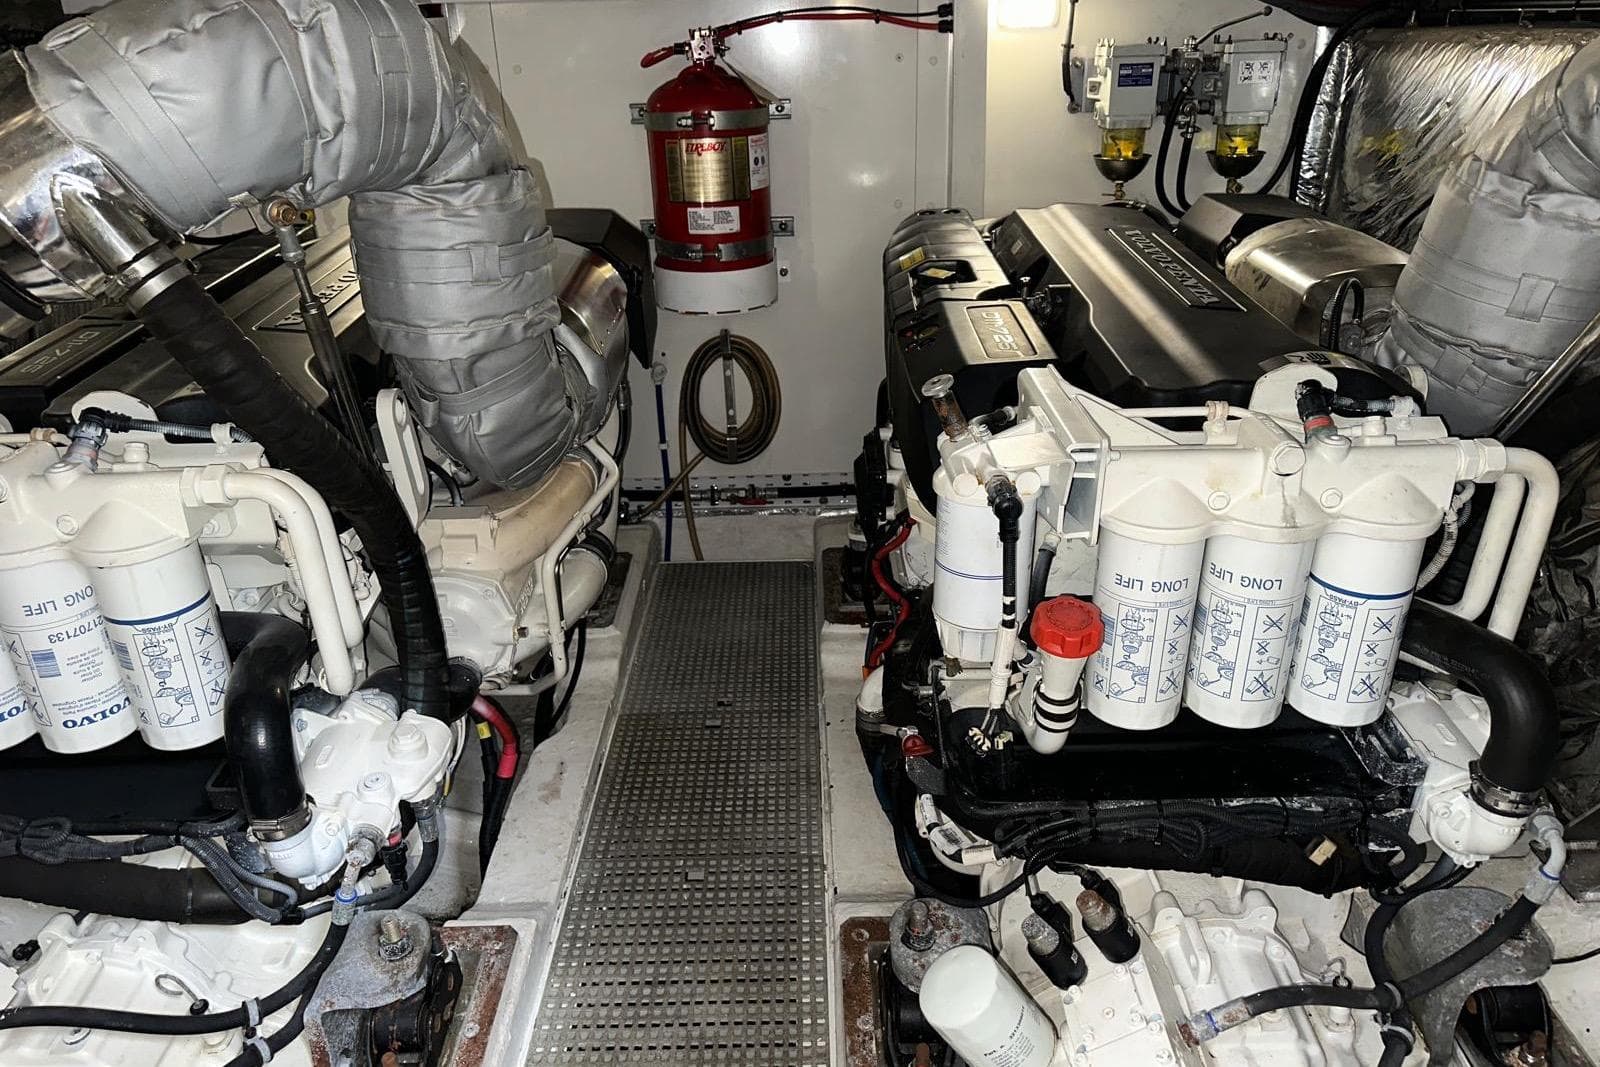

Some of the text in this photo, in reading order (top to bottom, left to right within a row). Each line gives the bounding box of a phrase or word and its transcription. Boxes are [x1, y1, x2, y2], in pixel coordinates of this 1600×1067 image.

[1125, 229, 1220, 304] VOLVO PENTA
[1113, 573, 1189, 593] LONG LIFE
[1209, 562, 1283, 591] LONG LIFE
[22, 600, 58, 617] LIFE
[63, 584, 94, 607] ONG
[47, 614, 104, 645] 21707133
[62, 696, 131, 729] VOLVO
